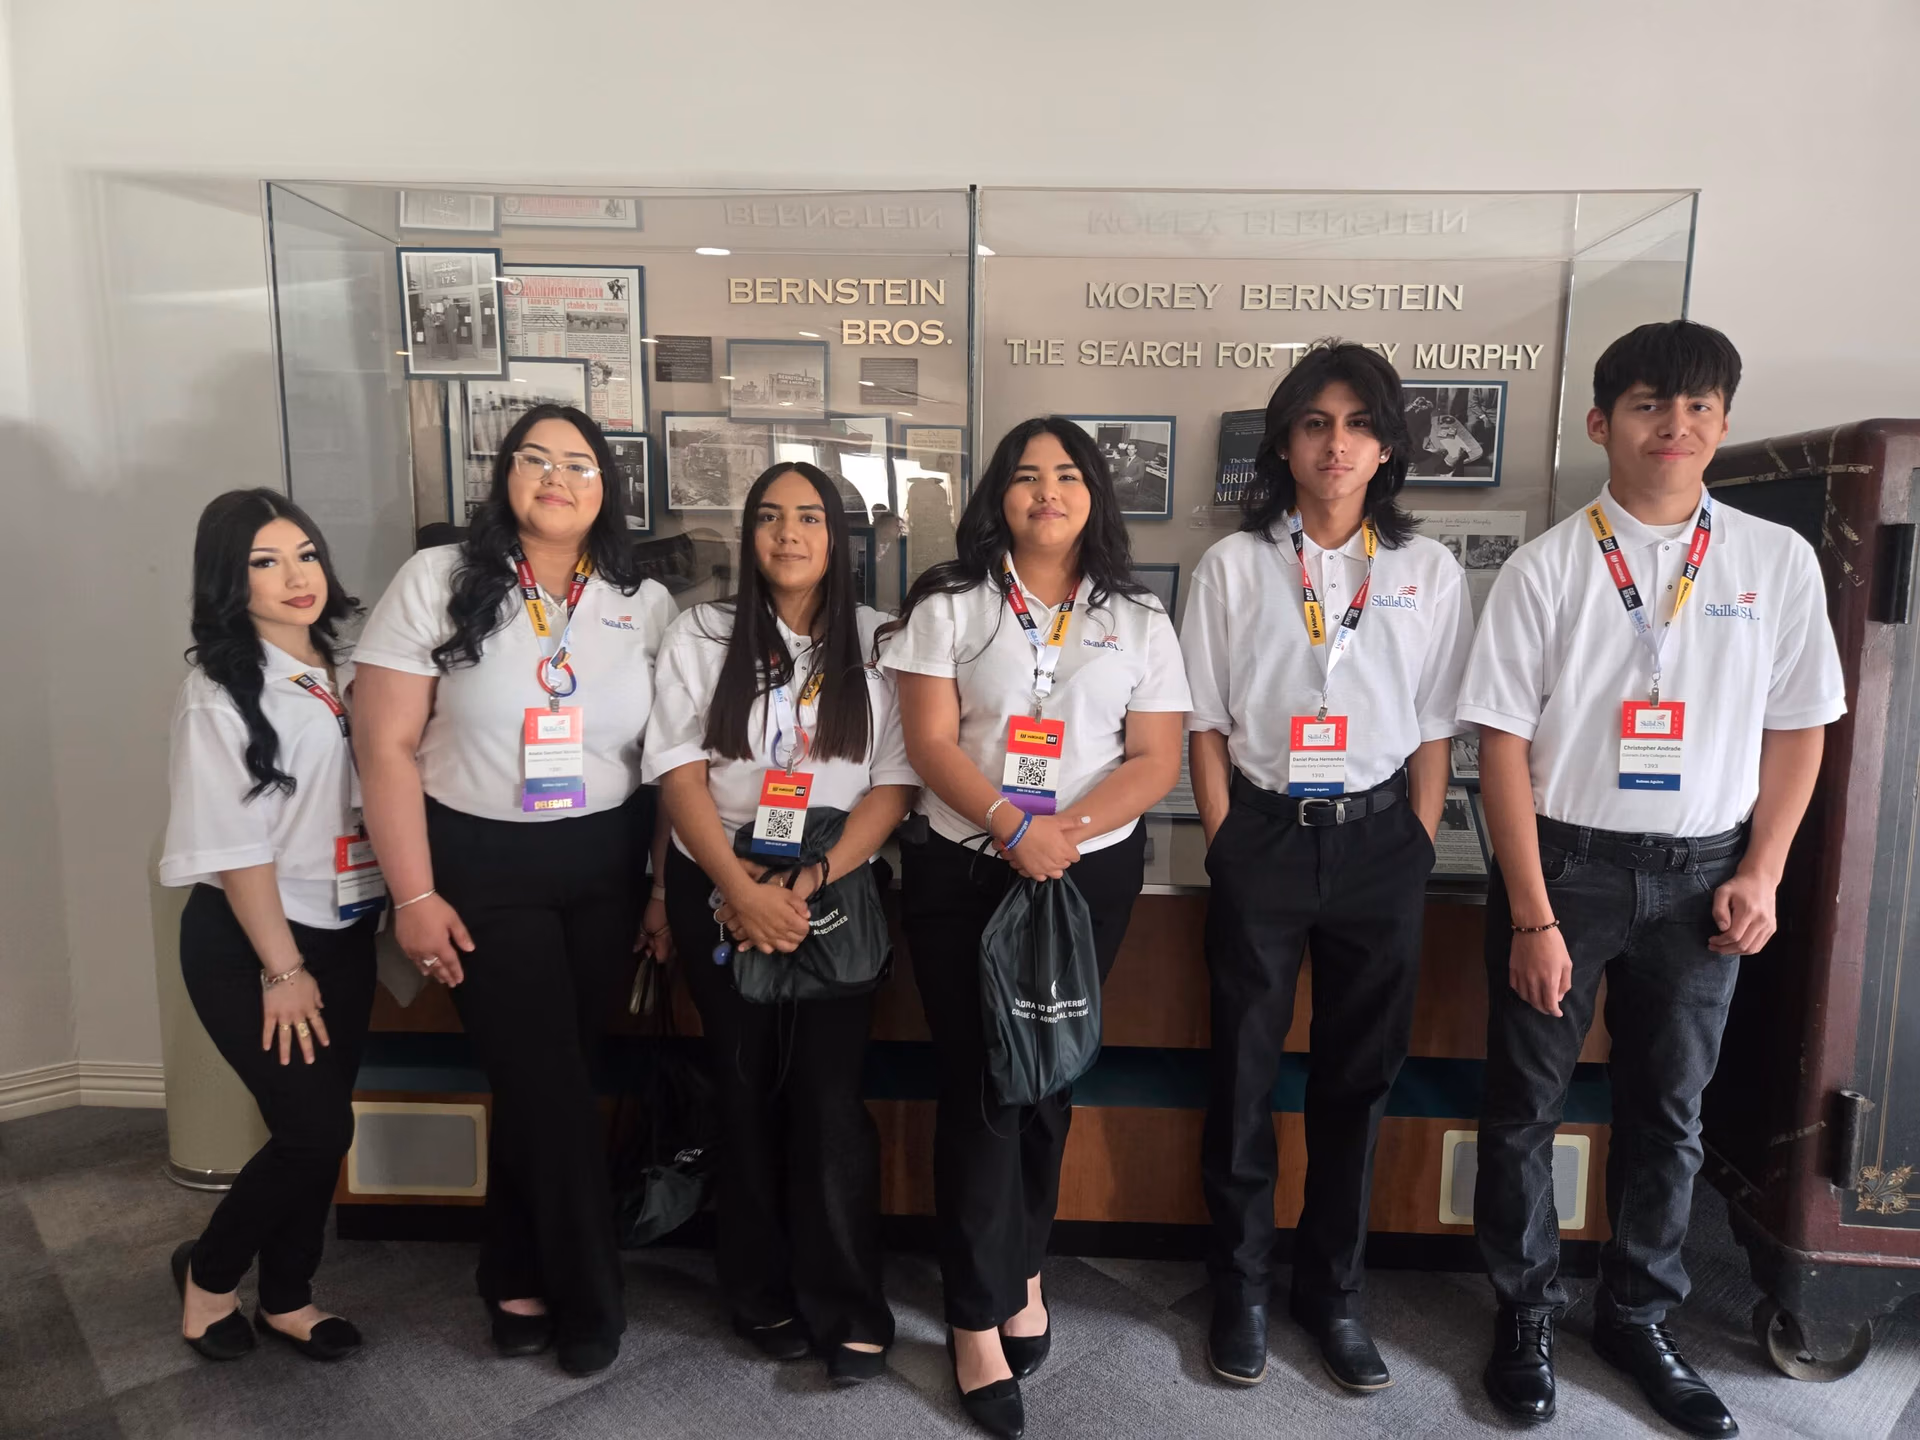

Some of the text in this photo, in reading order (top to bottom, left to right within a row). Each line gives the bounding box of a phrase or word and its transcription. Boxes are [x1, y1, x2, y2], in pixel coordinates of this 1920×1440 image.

[728, 278, 945, 306] BERNSTEIN
[1086, 281, 1465, 311] MOREY BERNSTEIN
[840, 319, 953, 346] BROS.
[1005, 338, 1066, 367] THE
[1078, 339, 1202, 367] SEARCH
[1216, 341, 1276, 369] FOR
[1414, 343, 1545, 371] MURPHY
[1603, 539, 1616, 550] CAT
[1686, 564, 1696, 579] CAT
[526, 588, 537, 600] CAT
[1306, 589, 1314, 601] CAT
[1371, 595, 1417, 611] SkillsUSA
[1704, 603, 1754, 620] SkillsUSA
[534, 798, 573, 810] DELEGATE
